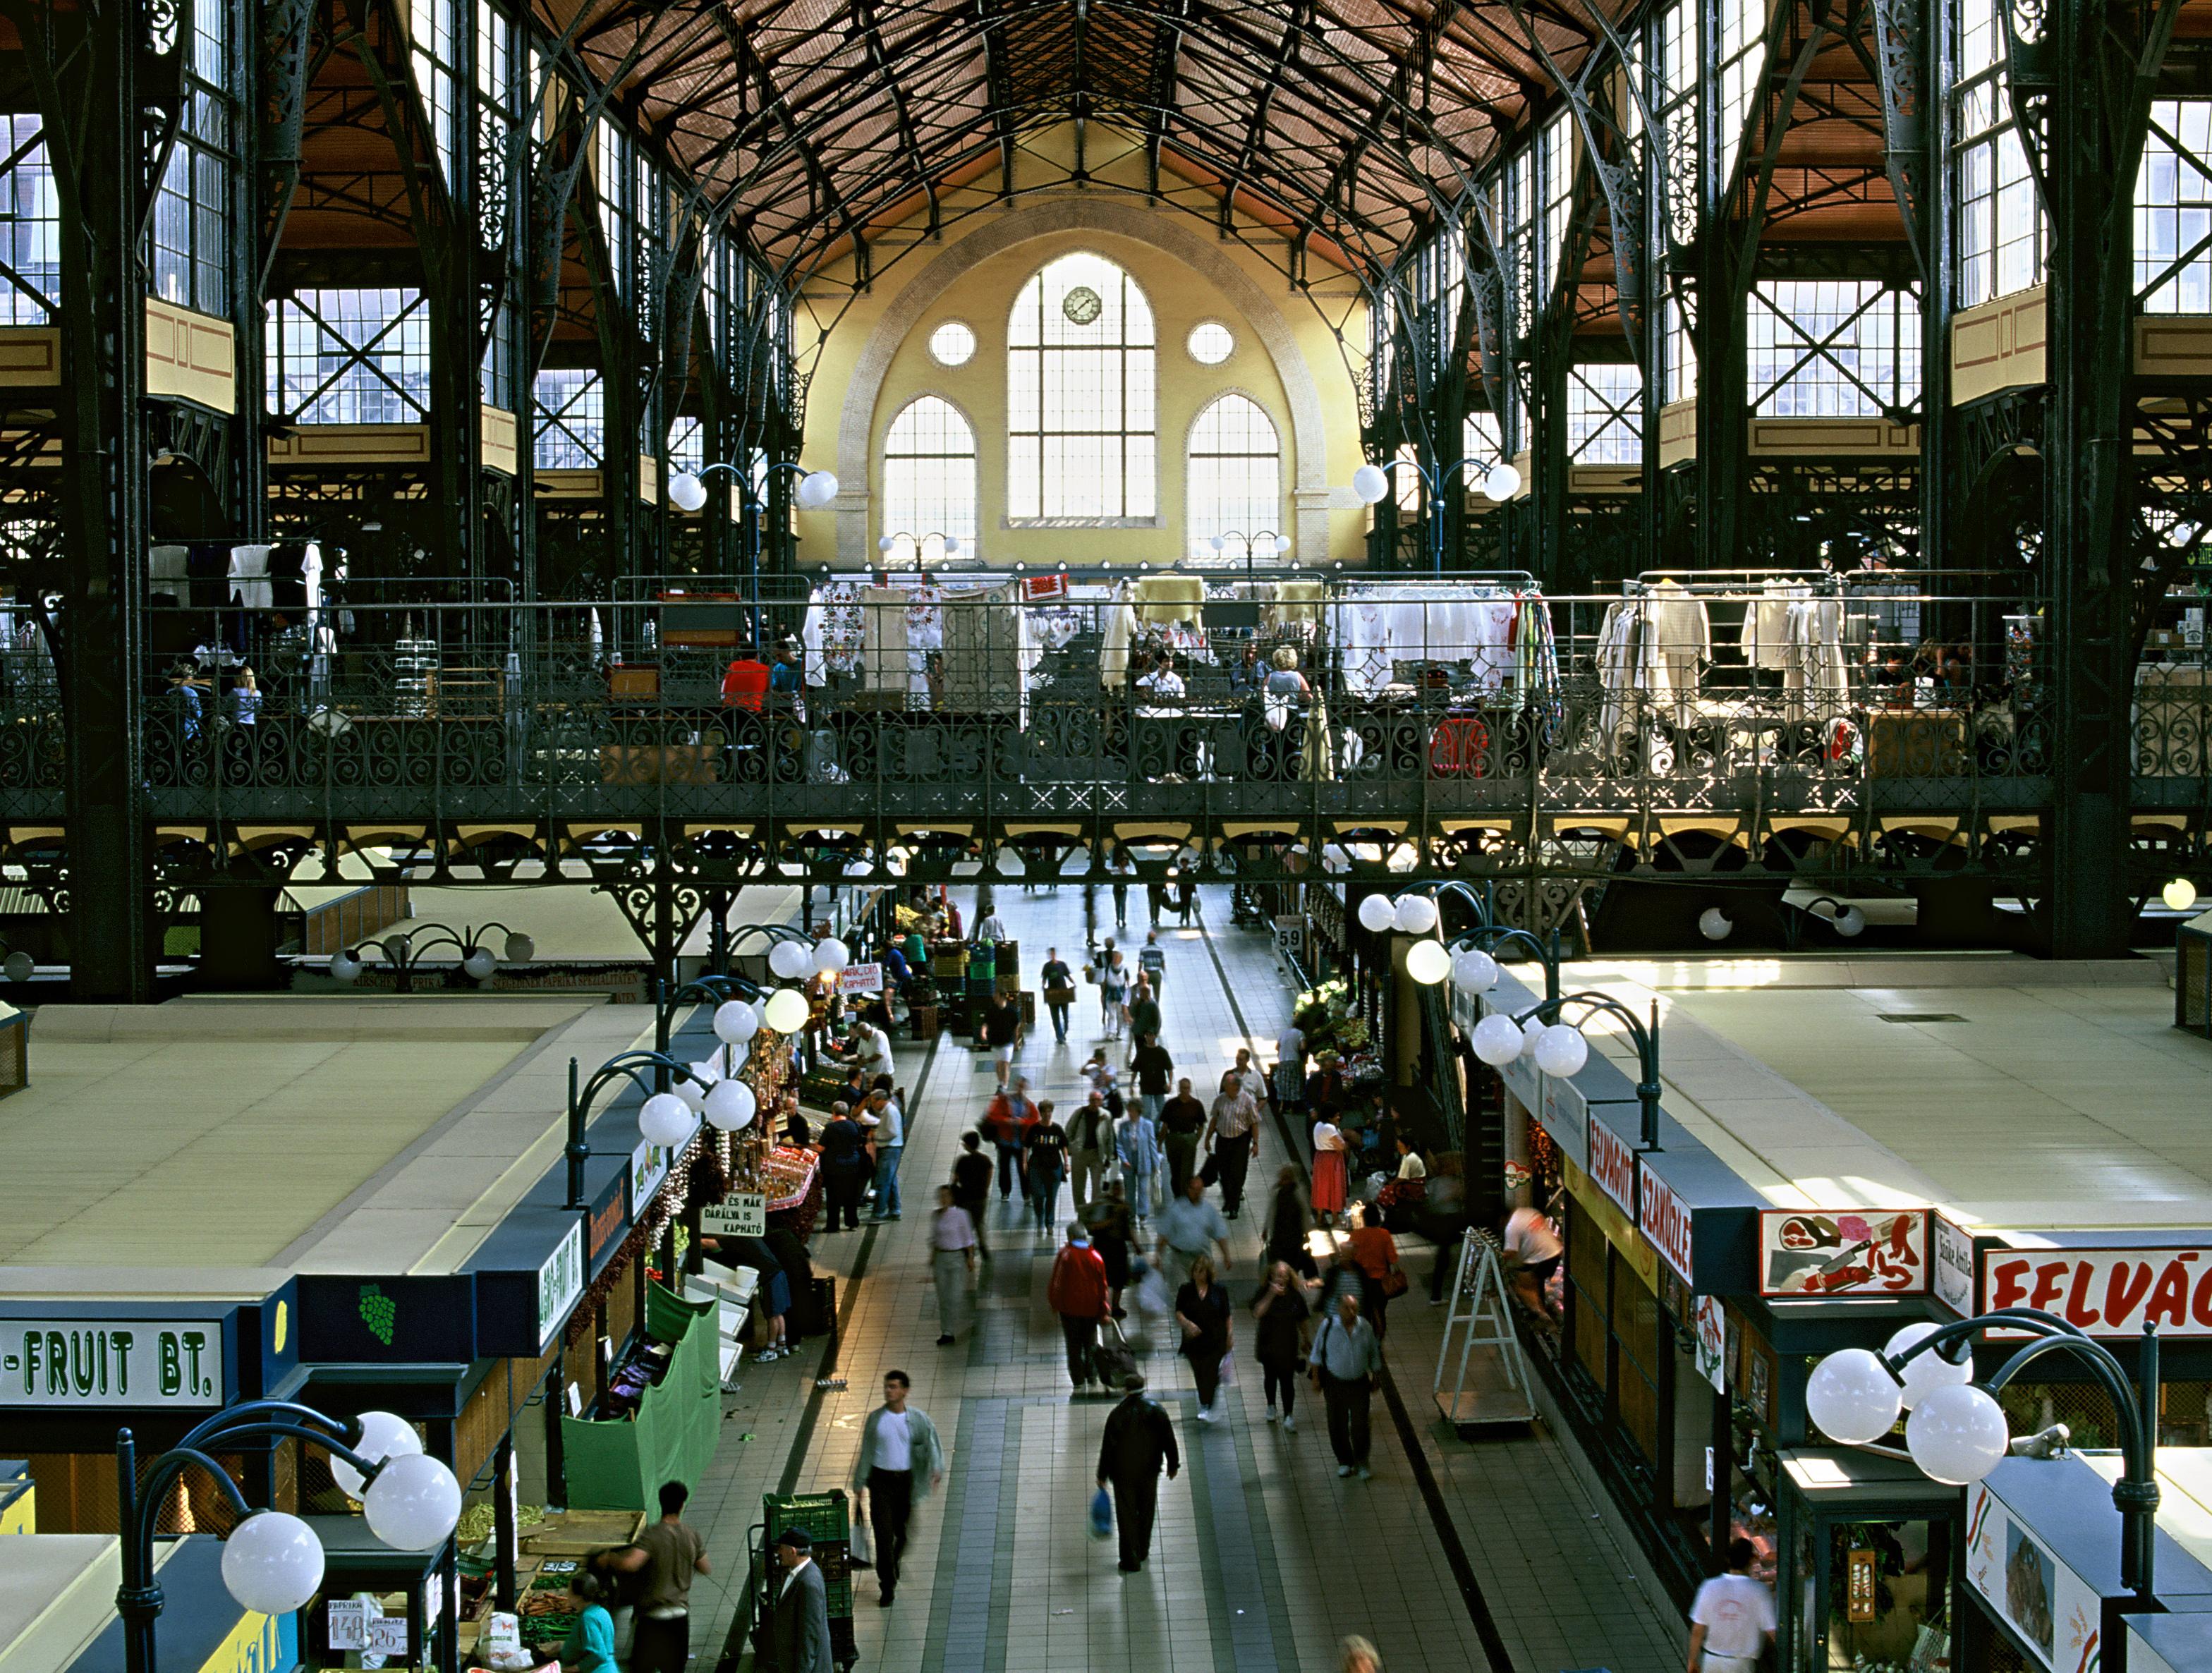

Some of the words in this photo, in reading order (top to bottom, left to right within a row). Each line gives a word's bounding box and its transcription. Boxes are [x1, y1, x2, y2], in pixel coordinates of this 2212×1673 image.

[1280, 930, 1299, 947] 59
[743, 1196, 761, 1207] MÁK
[705, 1208, 739, 1219] DARÁLVA
[743, 1212, 751, 1221] IS
[724, 1222, 762, 1234] KAPHATÓ
[159, 1331, 212, 1398] BT.
